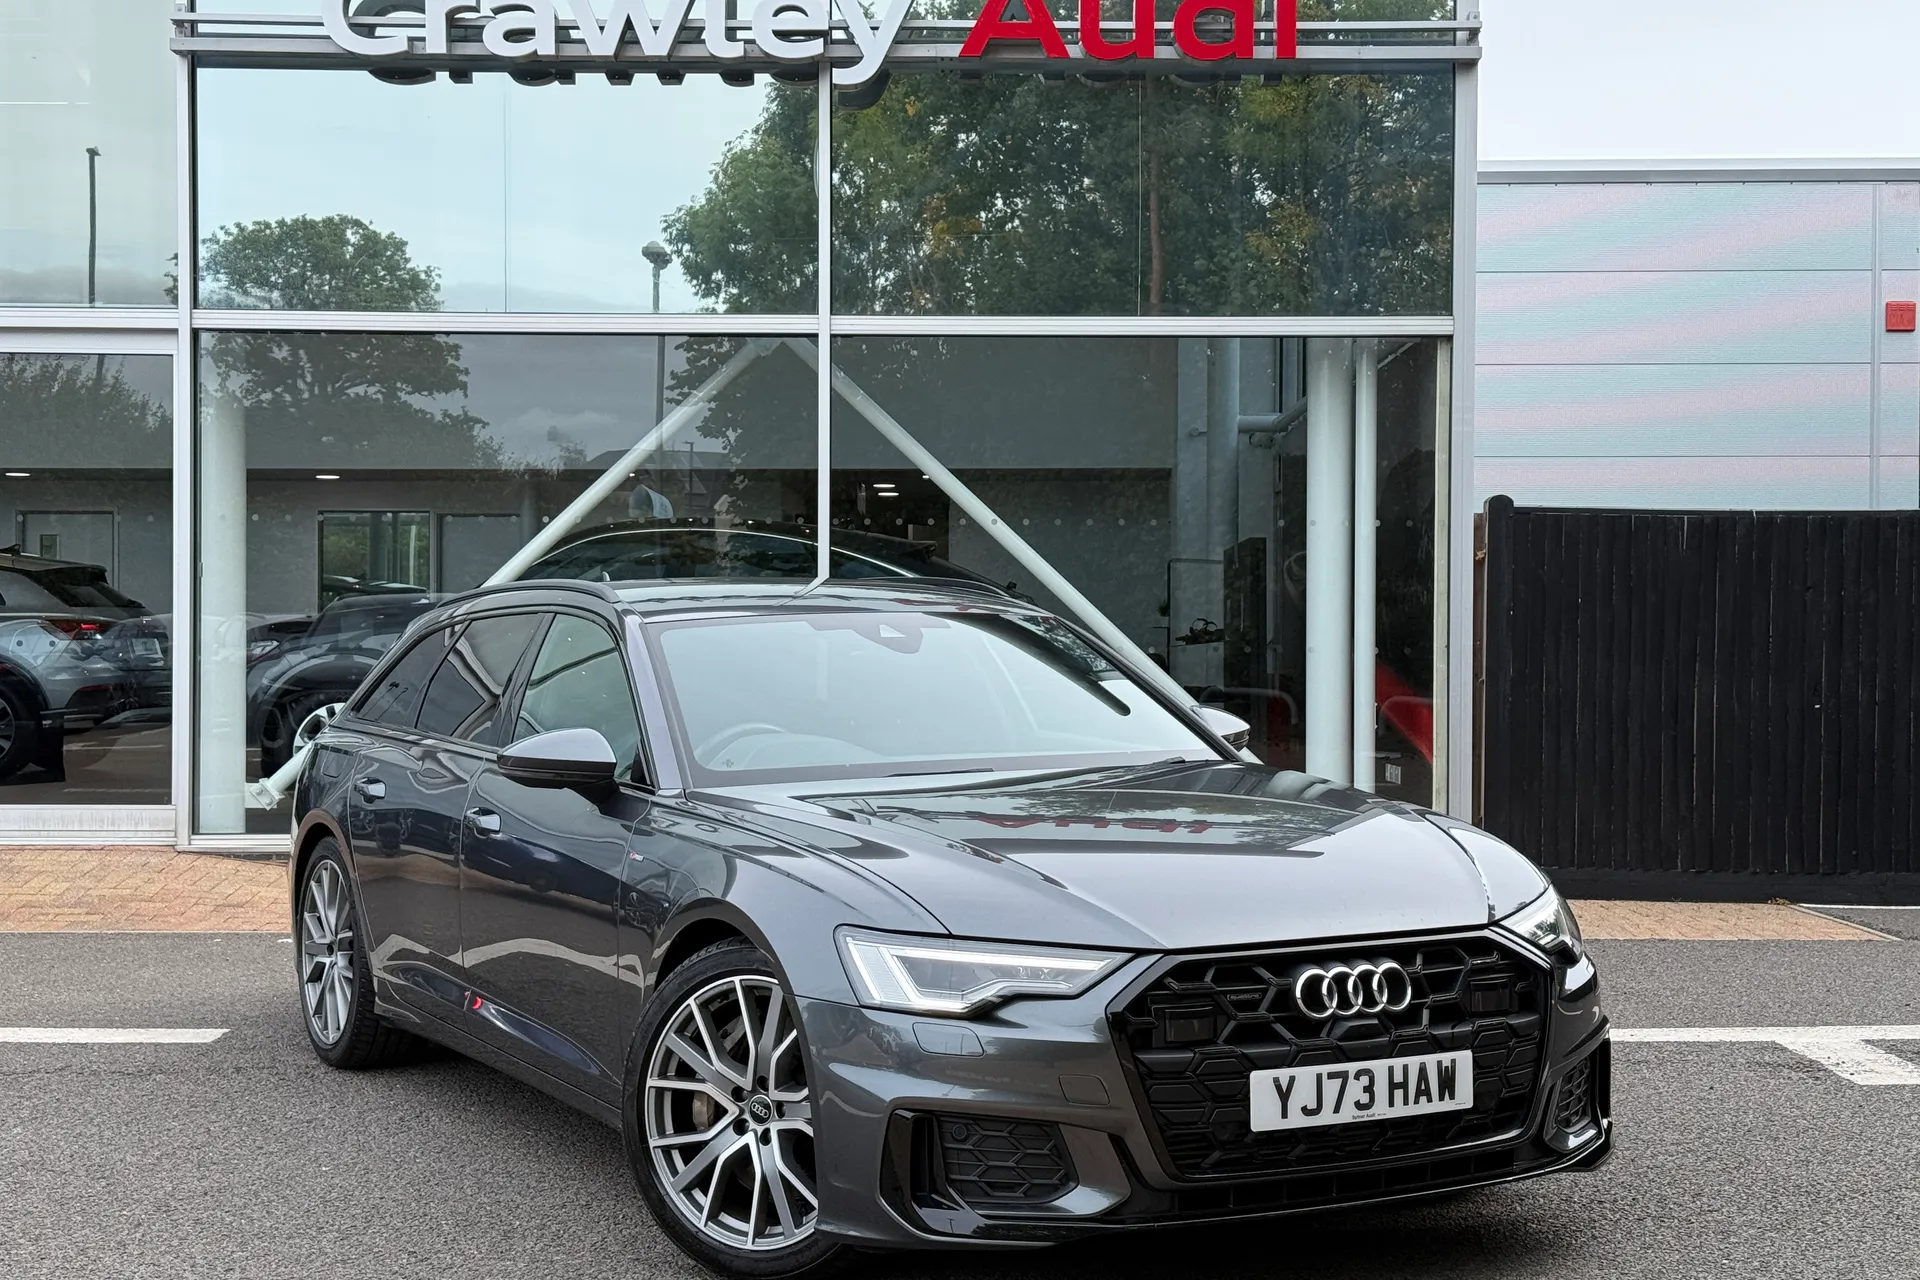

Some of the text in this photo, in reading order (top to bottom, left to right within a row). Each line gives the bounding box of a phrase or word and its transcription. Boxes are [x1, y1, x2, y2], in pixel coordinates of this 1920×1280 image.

[321, 0, 1297, 85] Crawley Audi
[1272, 1058, 1457, 1120] YJ73 HAW
